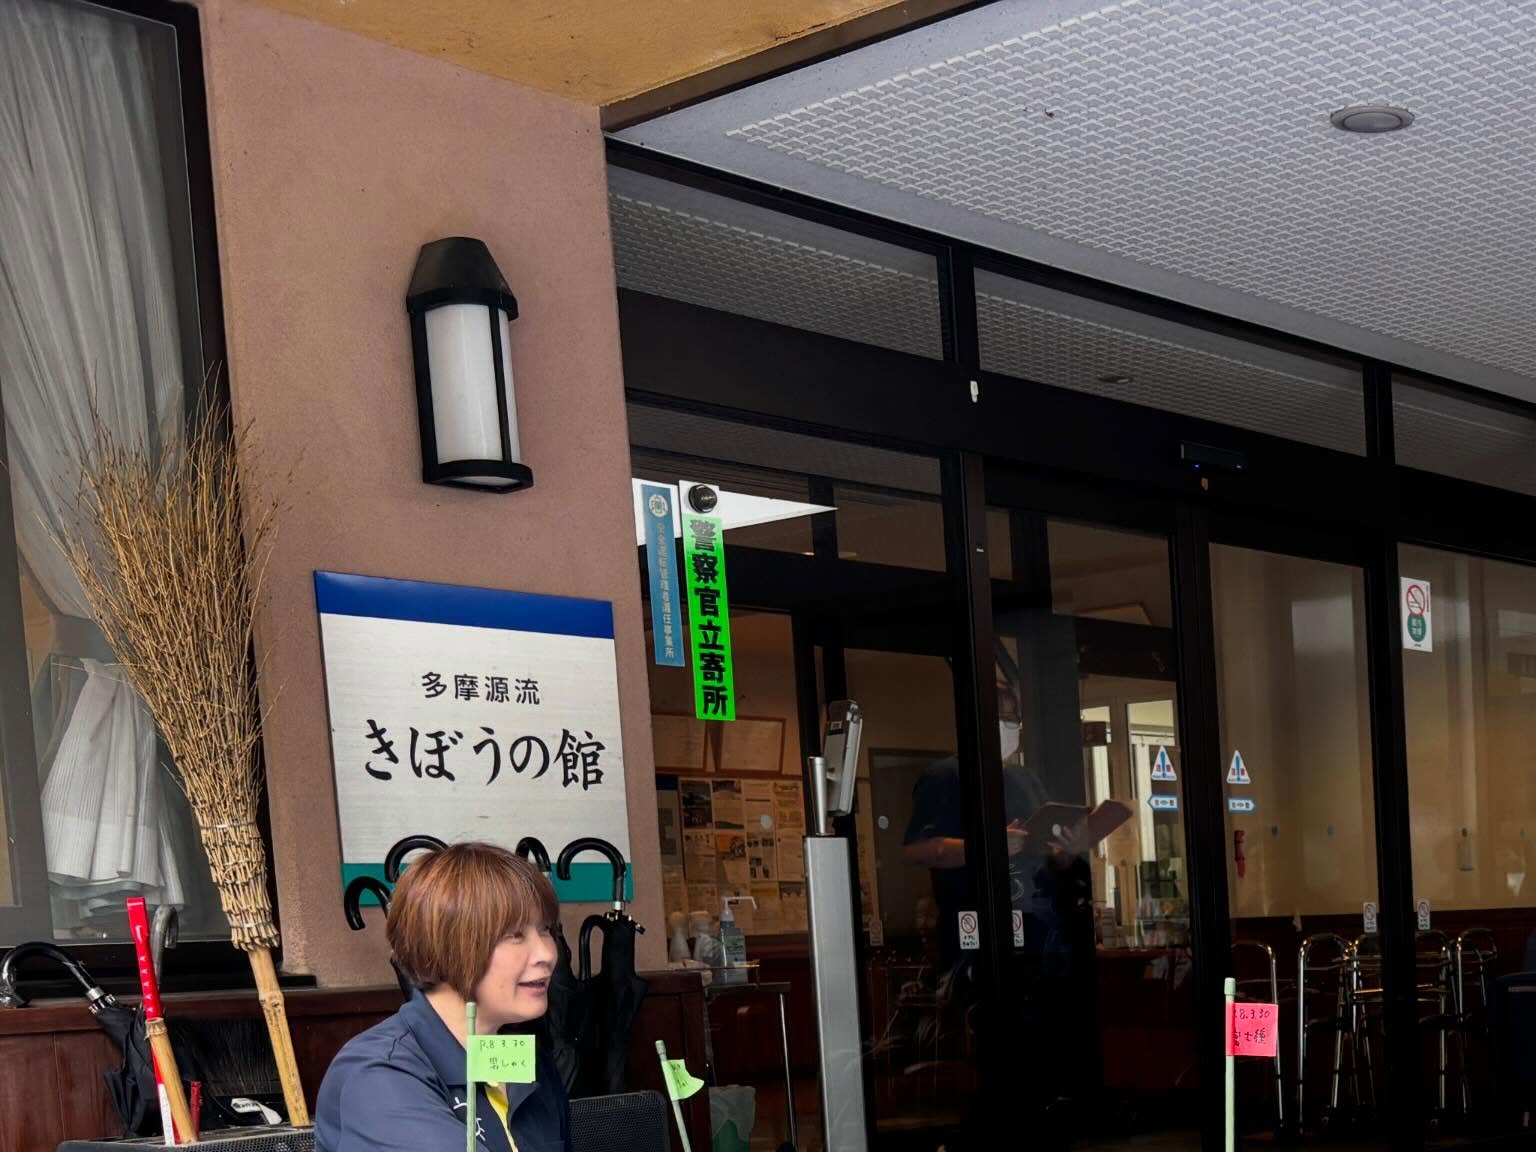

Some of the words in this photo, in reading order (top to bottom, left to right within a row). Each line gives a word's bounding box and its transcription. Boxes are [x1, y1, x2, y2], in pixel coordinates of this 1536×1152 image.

[689, 519, 729, 717] 警察官立寄所
[420, 671, 541, 706] 多摩源流
[364, 718, 607, 792] きぼうの館
